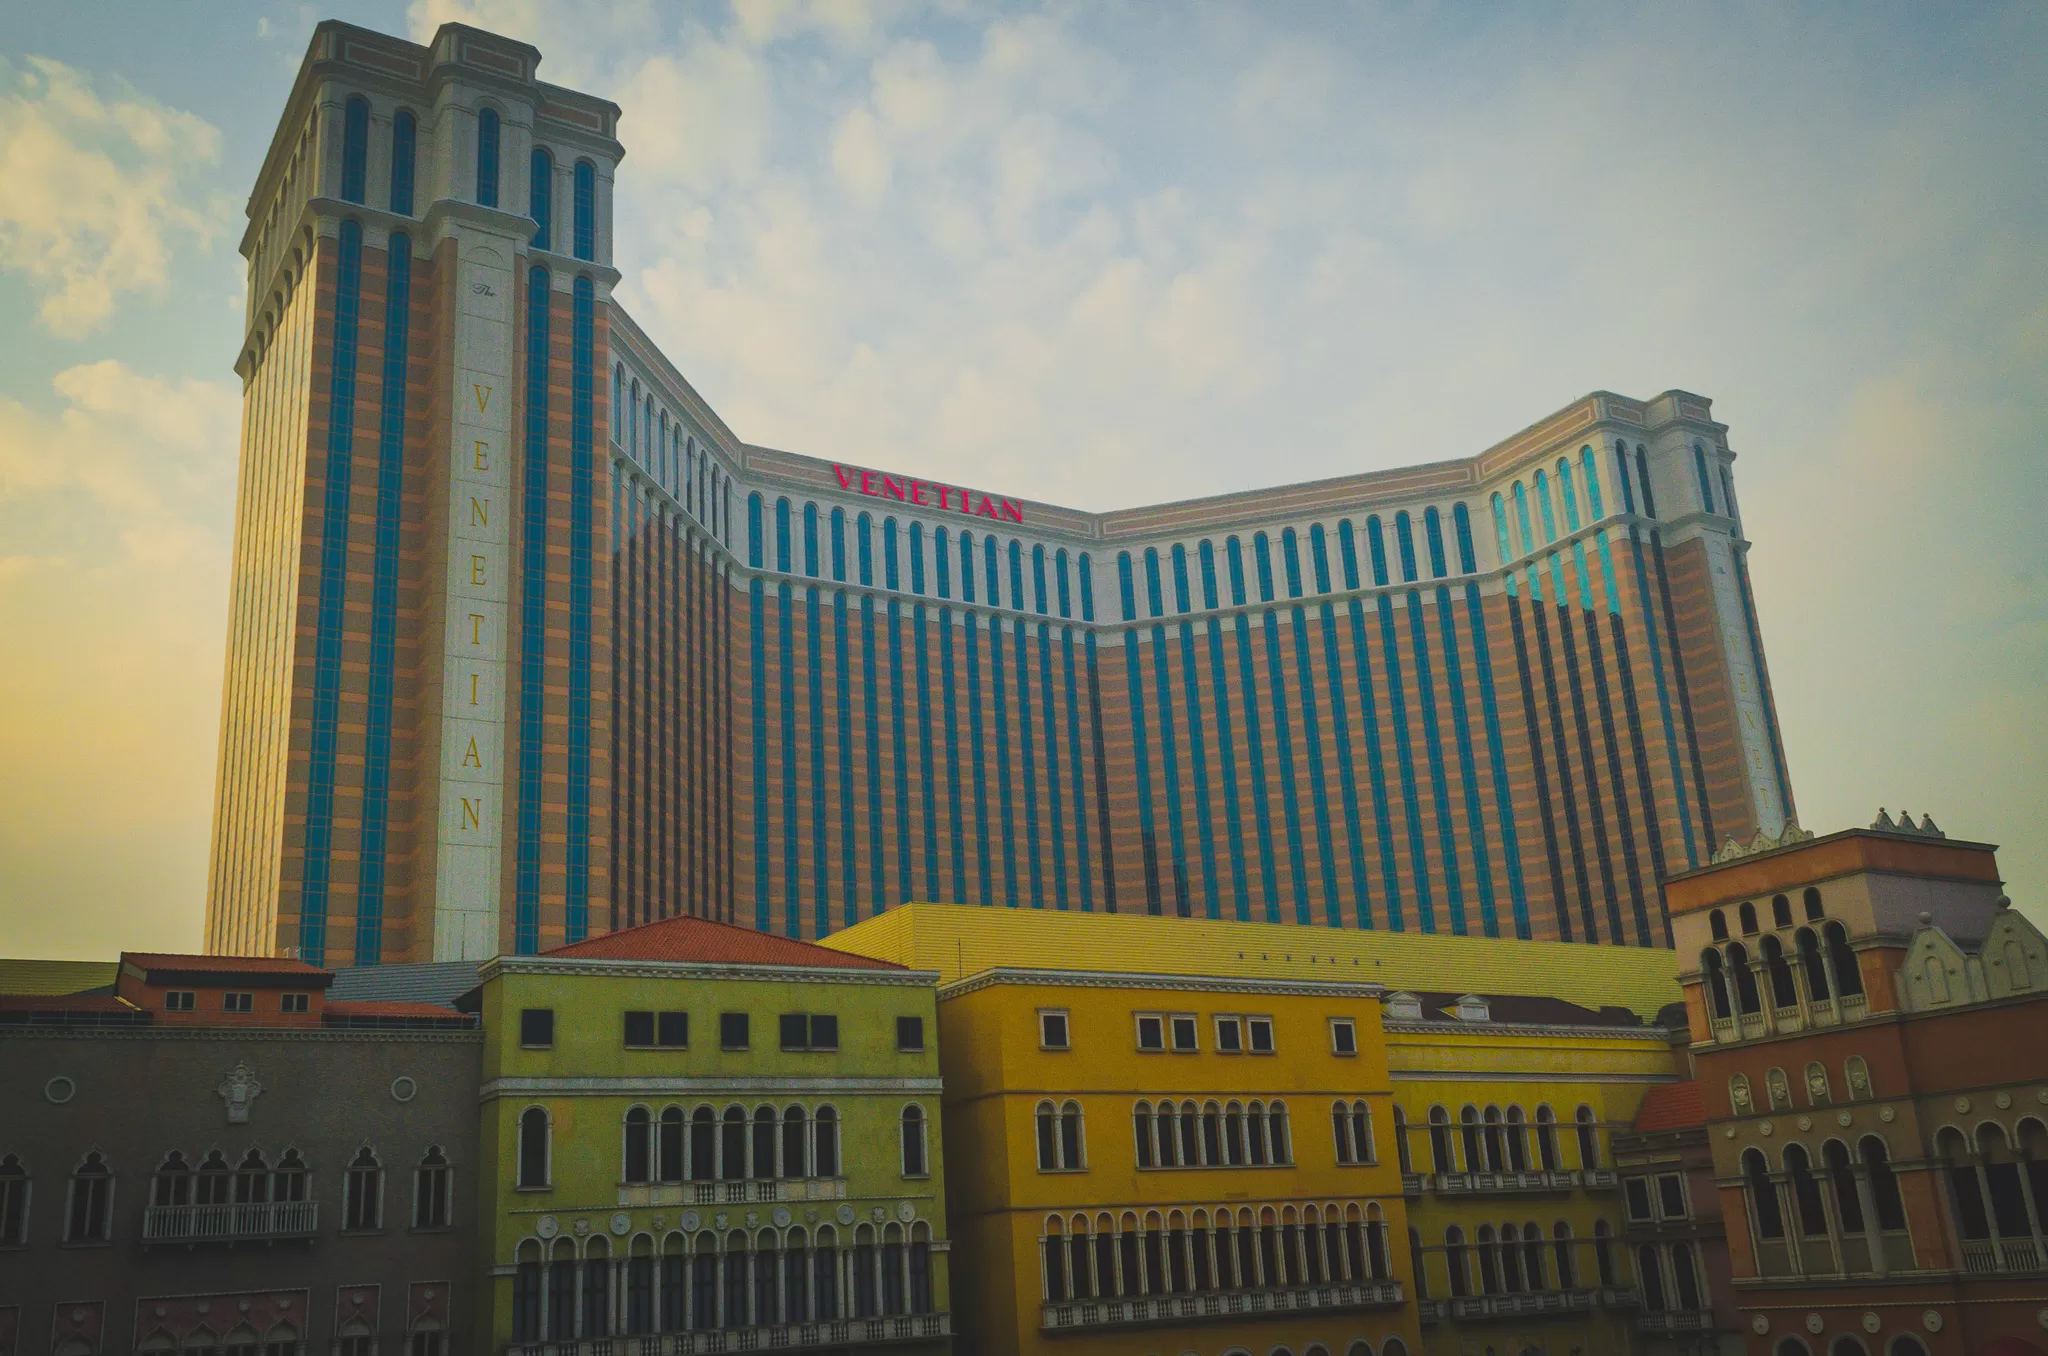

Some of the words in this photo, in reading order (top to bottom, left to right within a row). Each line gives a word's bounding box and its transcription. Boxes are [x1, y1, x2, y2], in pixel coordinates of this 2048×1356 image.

[472, 282, 496, 297] The
[832, 463, 1025, 524] VENETIAN
[460, 384, 493, 831] VENETIAN
